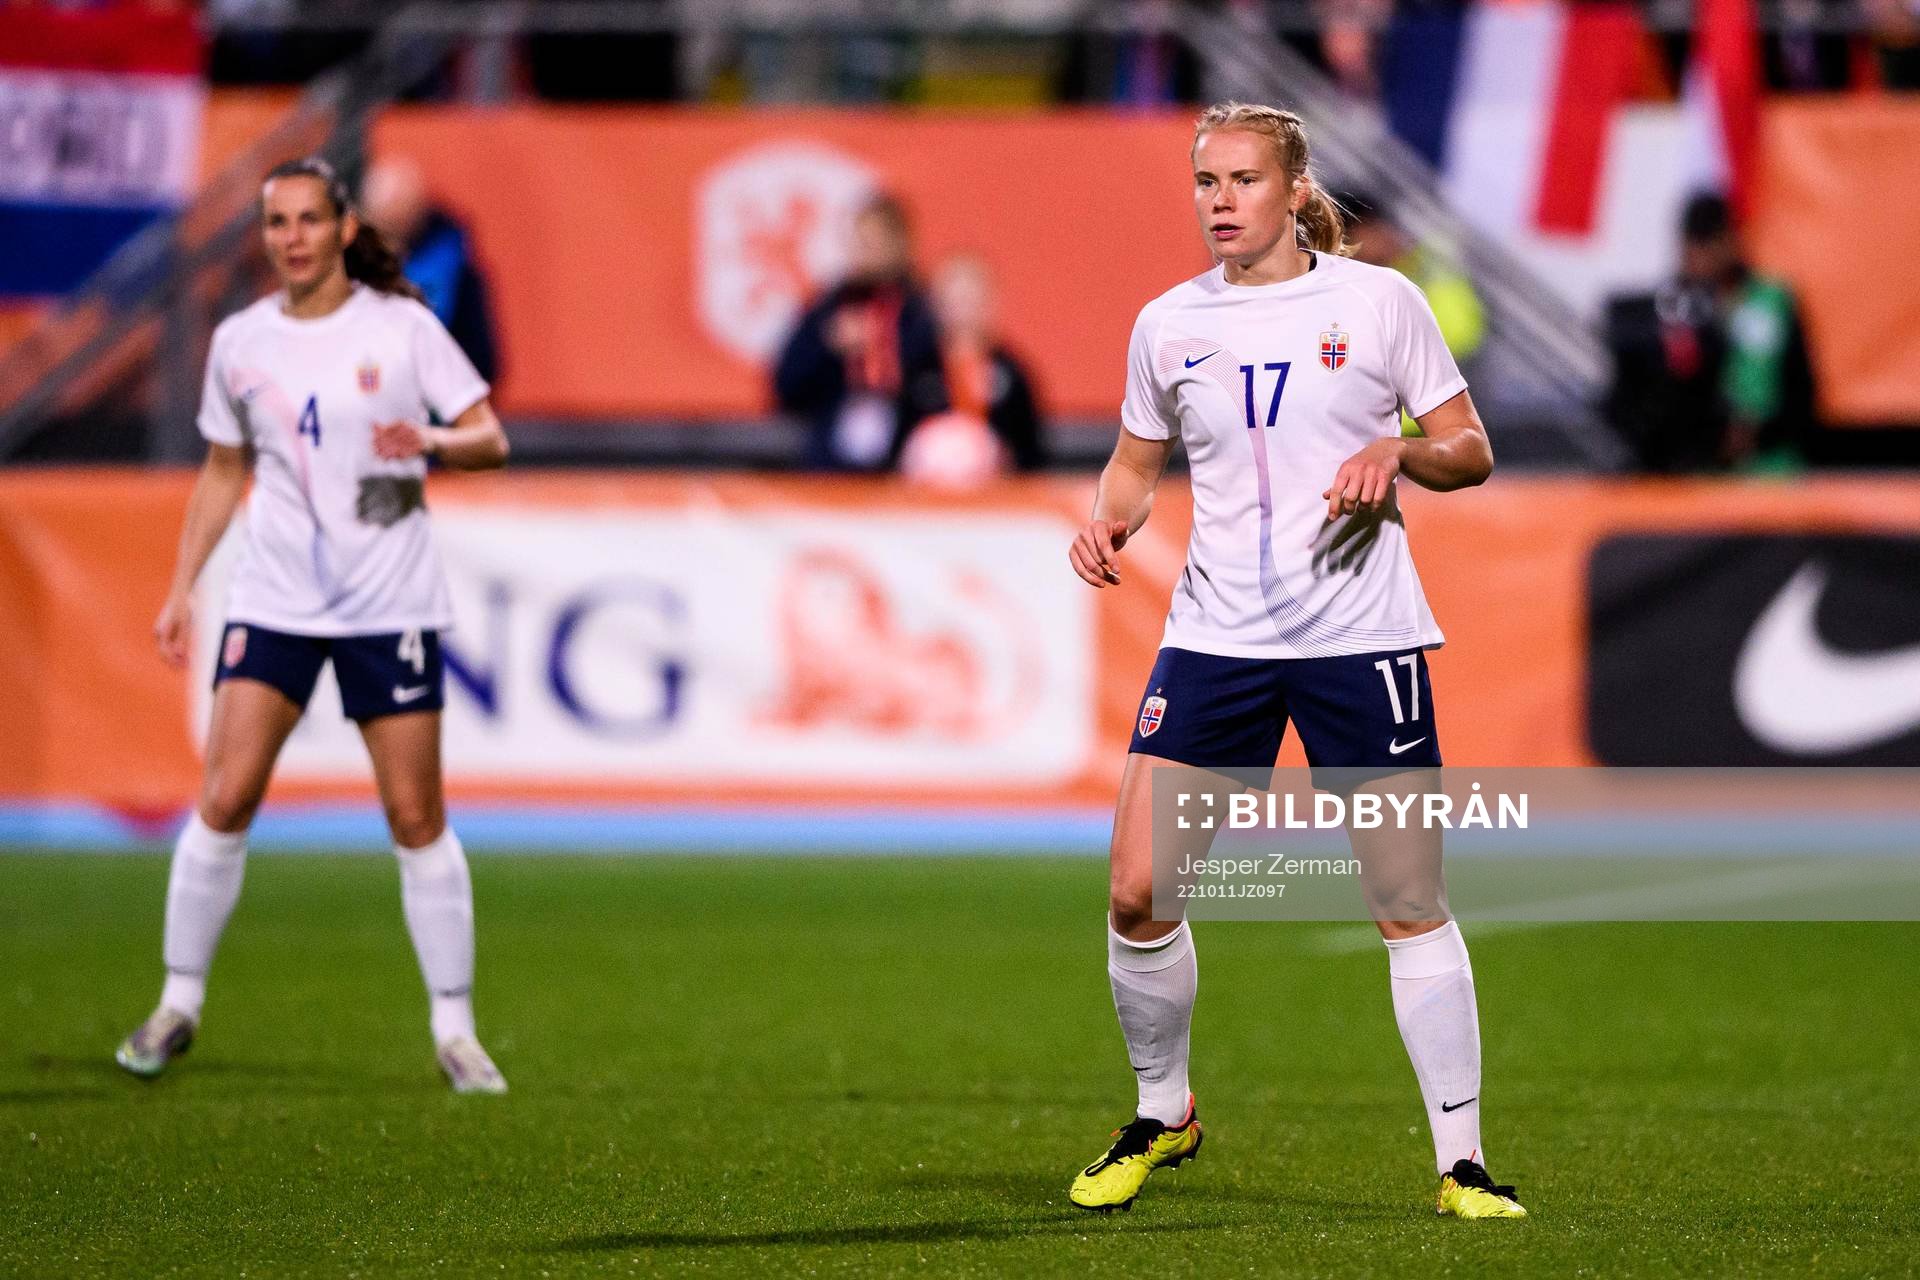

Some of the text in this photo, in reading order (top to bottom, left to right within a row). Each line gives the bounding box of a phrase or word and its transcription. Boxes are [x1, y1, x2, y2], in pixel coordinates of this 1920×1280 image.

[298, 394, 321, 447] 4
[1240, 362, 1291, 428] 17
[397, 628, 425, 675] 4
[441, 575, 690, 742] NG
[1374, 653, 1419, 724] 17
